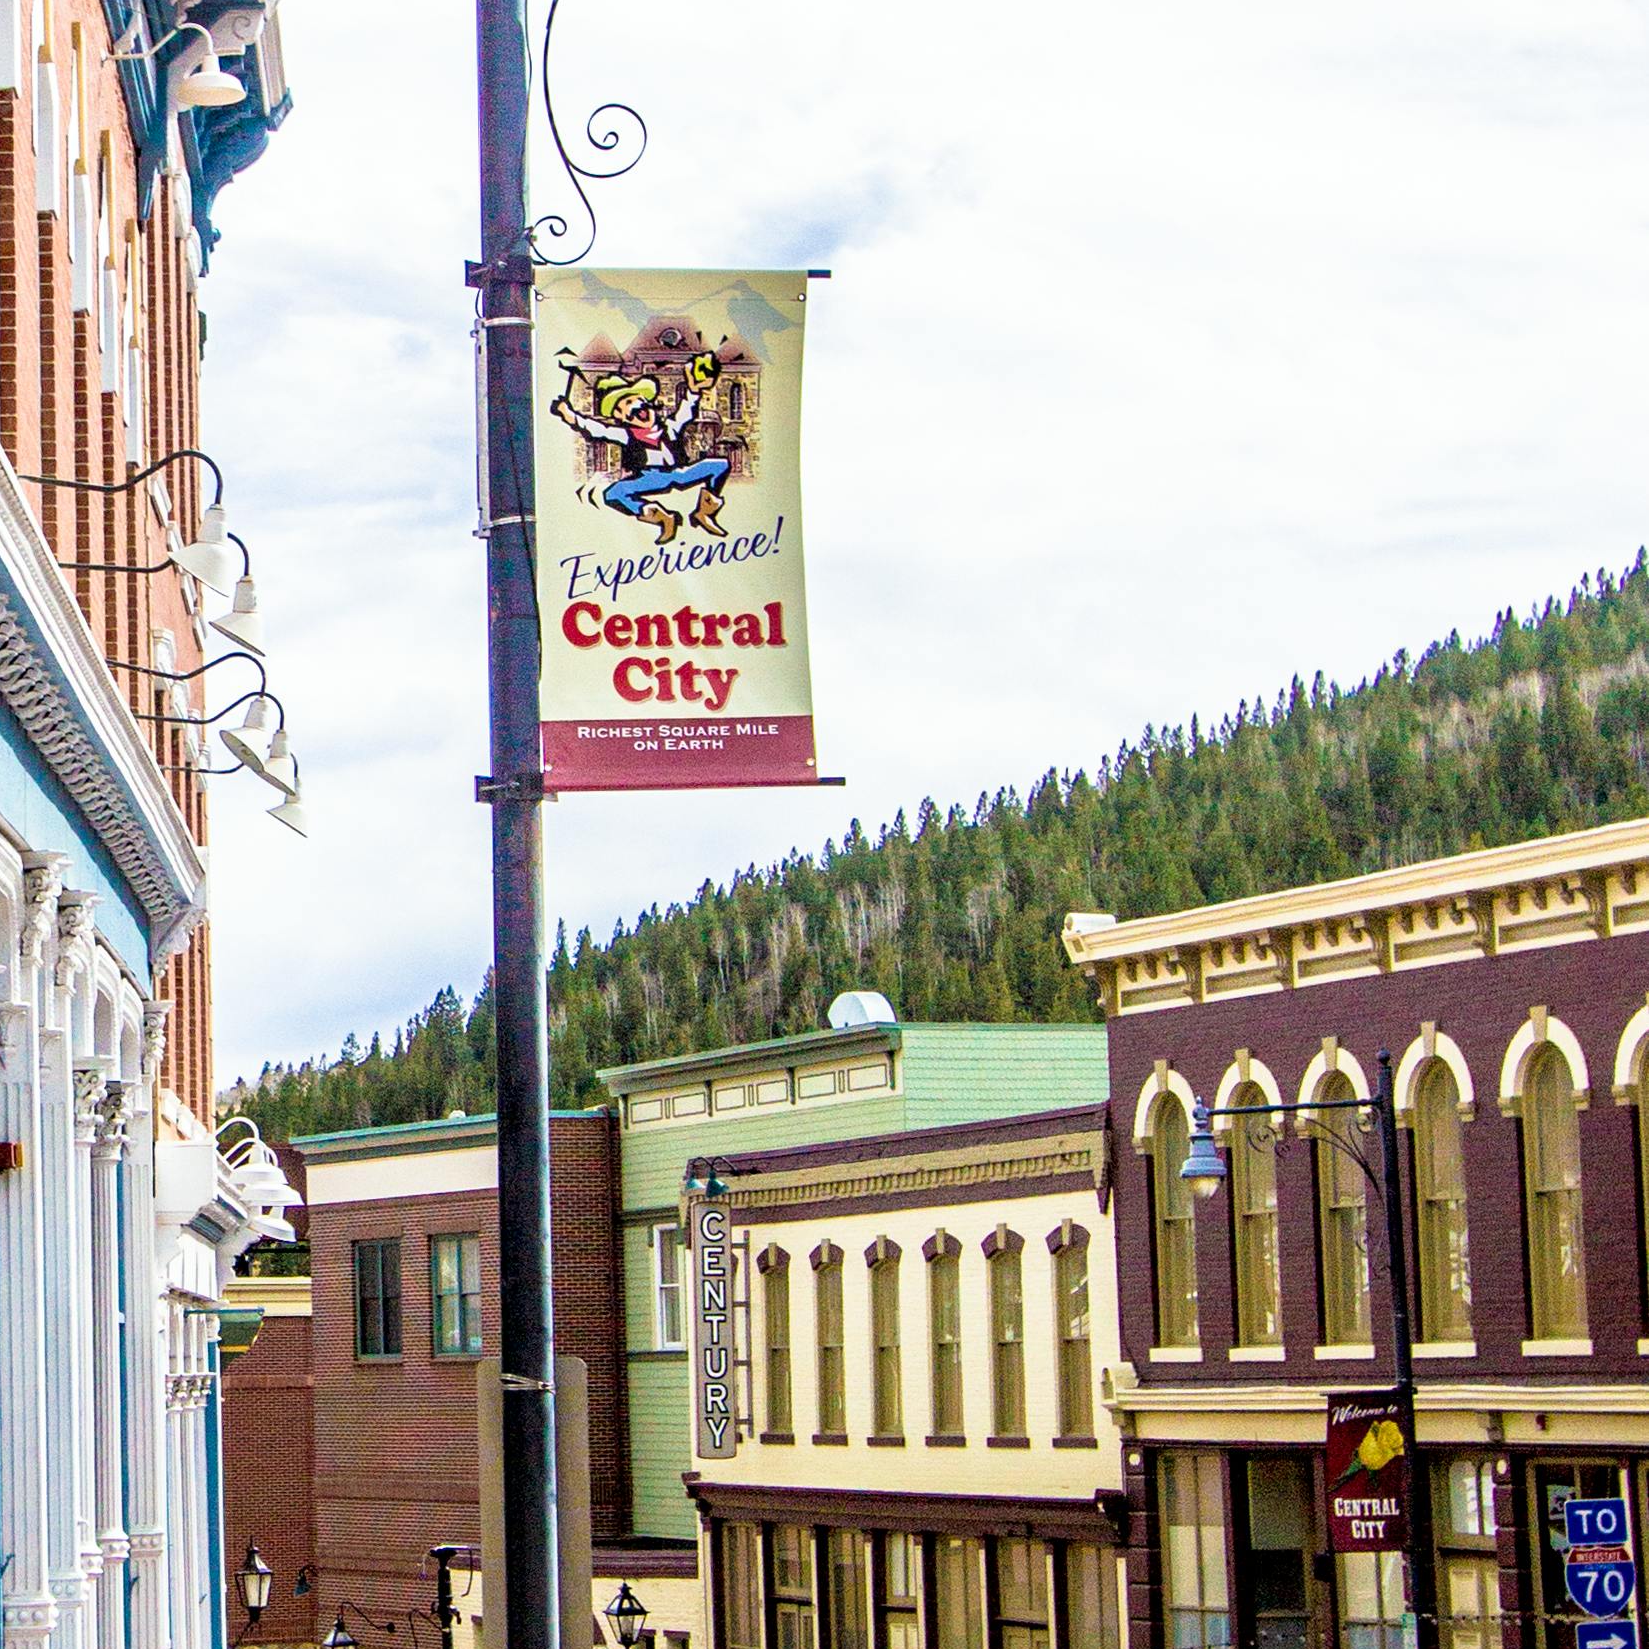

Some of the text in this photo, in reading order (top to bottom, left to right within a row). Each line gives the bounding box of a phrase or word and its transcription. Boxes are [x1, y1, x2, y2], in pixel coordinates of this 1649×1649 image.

[560, 516, 784, 601] Experience!
[561, 602, 787, 648] Central
[613, 657, 739, 712] City
[577, 723, 780, 739] RICHEST SQUARE MILE
[664, 738, 725, 751] EARTH
[700, 1211, 731, 1450] CENTURY
[1332, 1403, 1399, 1426] Welcome to
[1333, 1497, 1400, 1517] CENTRAL
[1351, 1519, 1386, 1539] CITY
[1575, 1508, 1617, 1534] TO
[1577, 1570, 1625, 1602] 70
